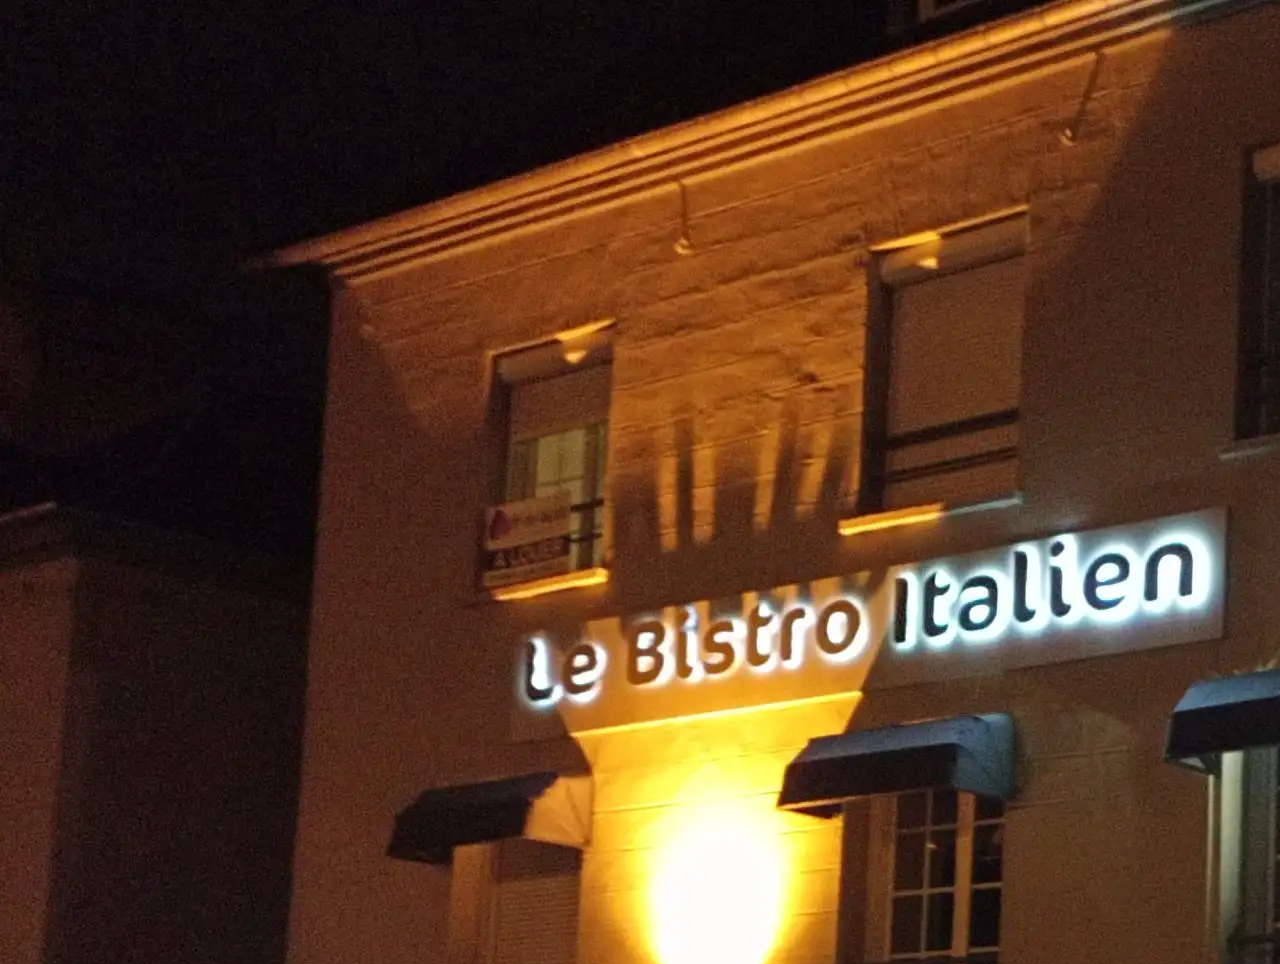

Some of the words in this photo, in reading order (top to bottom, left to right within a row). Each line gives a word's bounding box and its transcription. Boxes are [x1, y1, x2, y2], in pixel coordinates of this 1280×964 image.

[525, 639, 598, 701] Le
[626, 598, 861, 686] Bistro
[893, 540, 1194, 644] Italien
